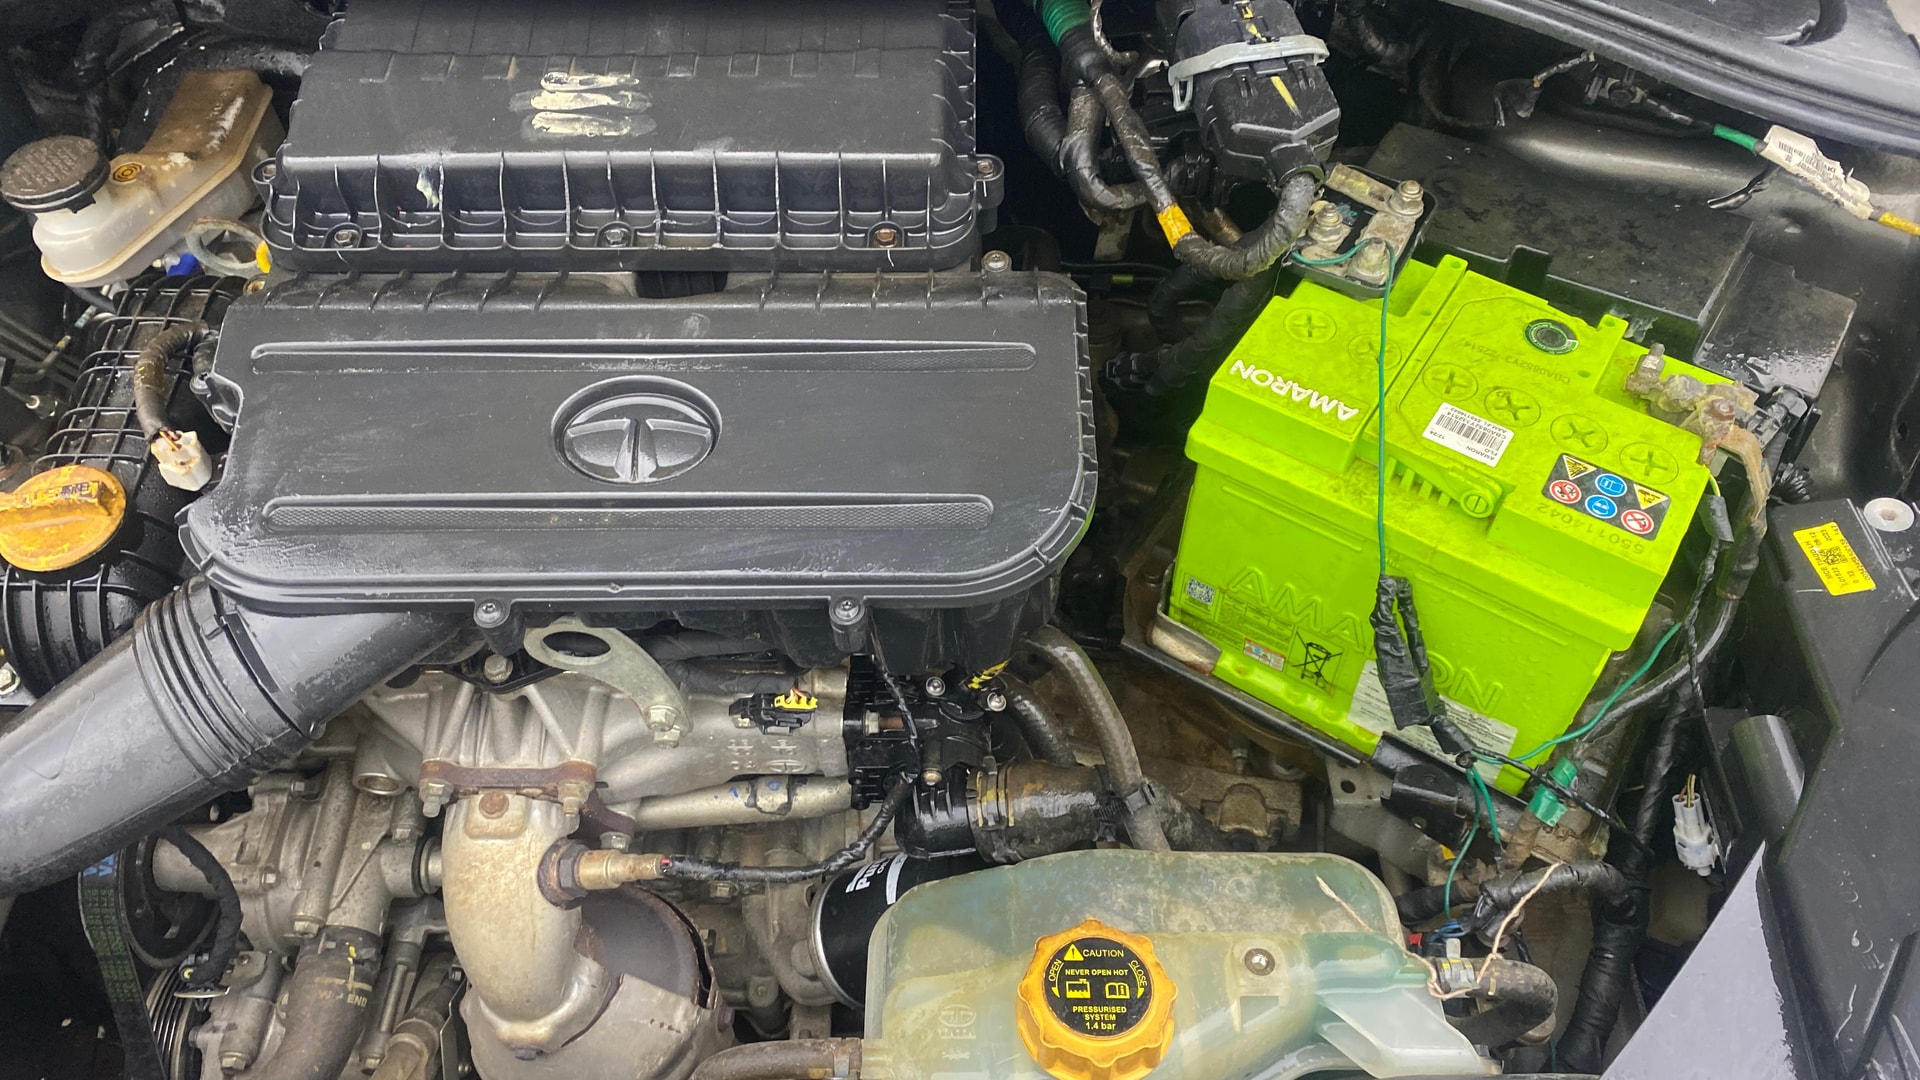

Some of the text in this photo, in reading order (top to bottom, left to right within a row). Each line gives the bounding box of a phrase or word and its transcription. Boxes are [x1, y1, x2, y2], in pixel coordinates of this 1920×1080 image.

[1230, 360, 1359, 420] AMARON
[1466, 446, 1495, 460] AMARON
[1484, 448, 1498, 456] FLO
[1537, 503, 1645, 554] 550114042
[1804, 540, 1814, 549] LH
[1810, 550, 1824, 566] TIAGO
[1228, 566, 1503, 714] AMAON
[1083, 949, 1124, 958] CAUTION
[1048, 959, 1062, 982] OPEN
[1130, 960, 1148, 987] CLOSE
[348, 993, 368, 1007] END
[1086, 1022, 1116, 1030] 1.4 bar
